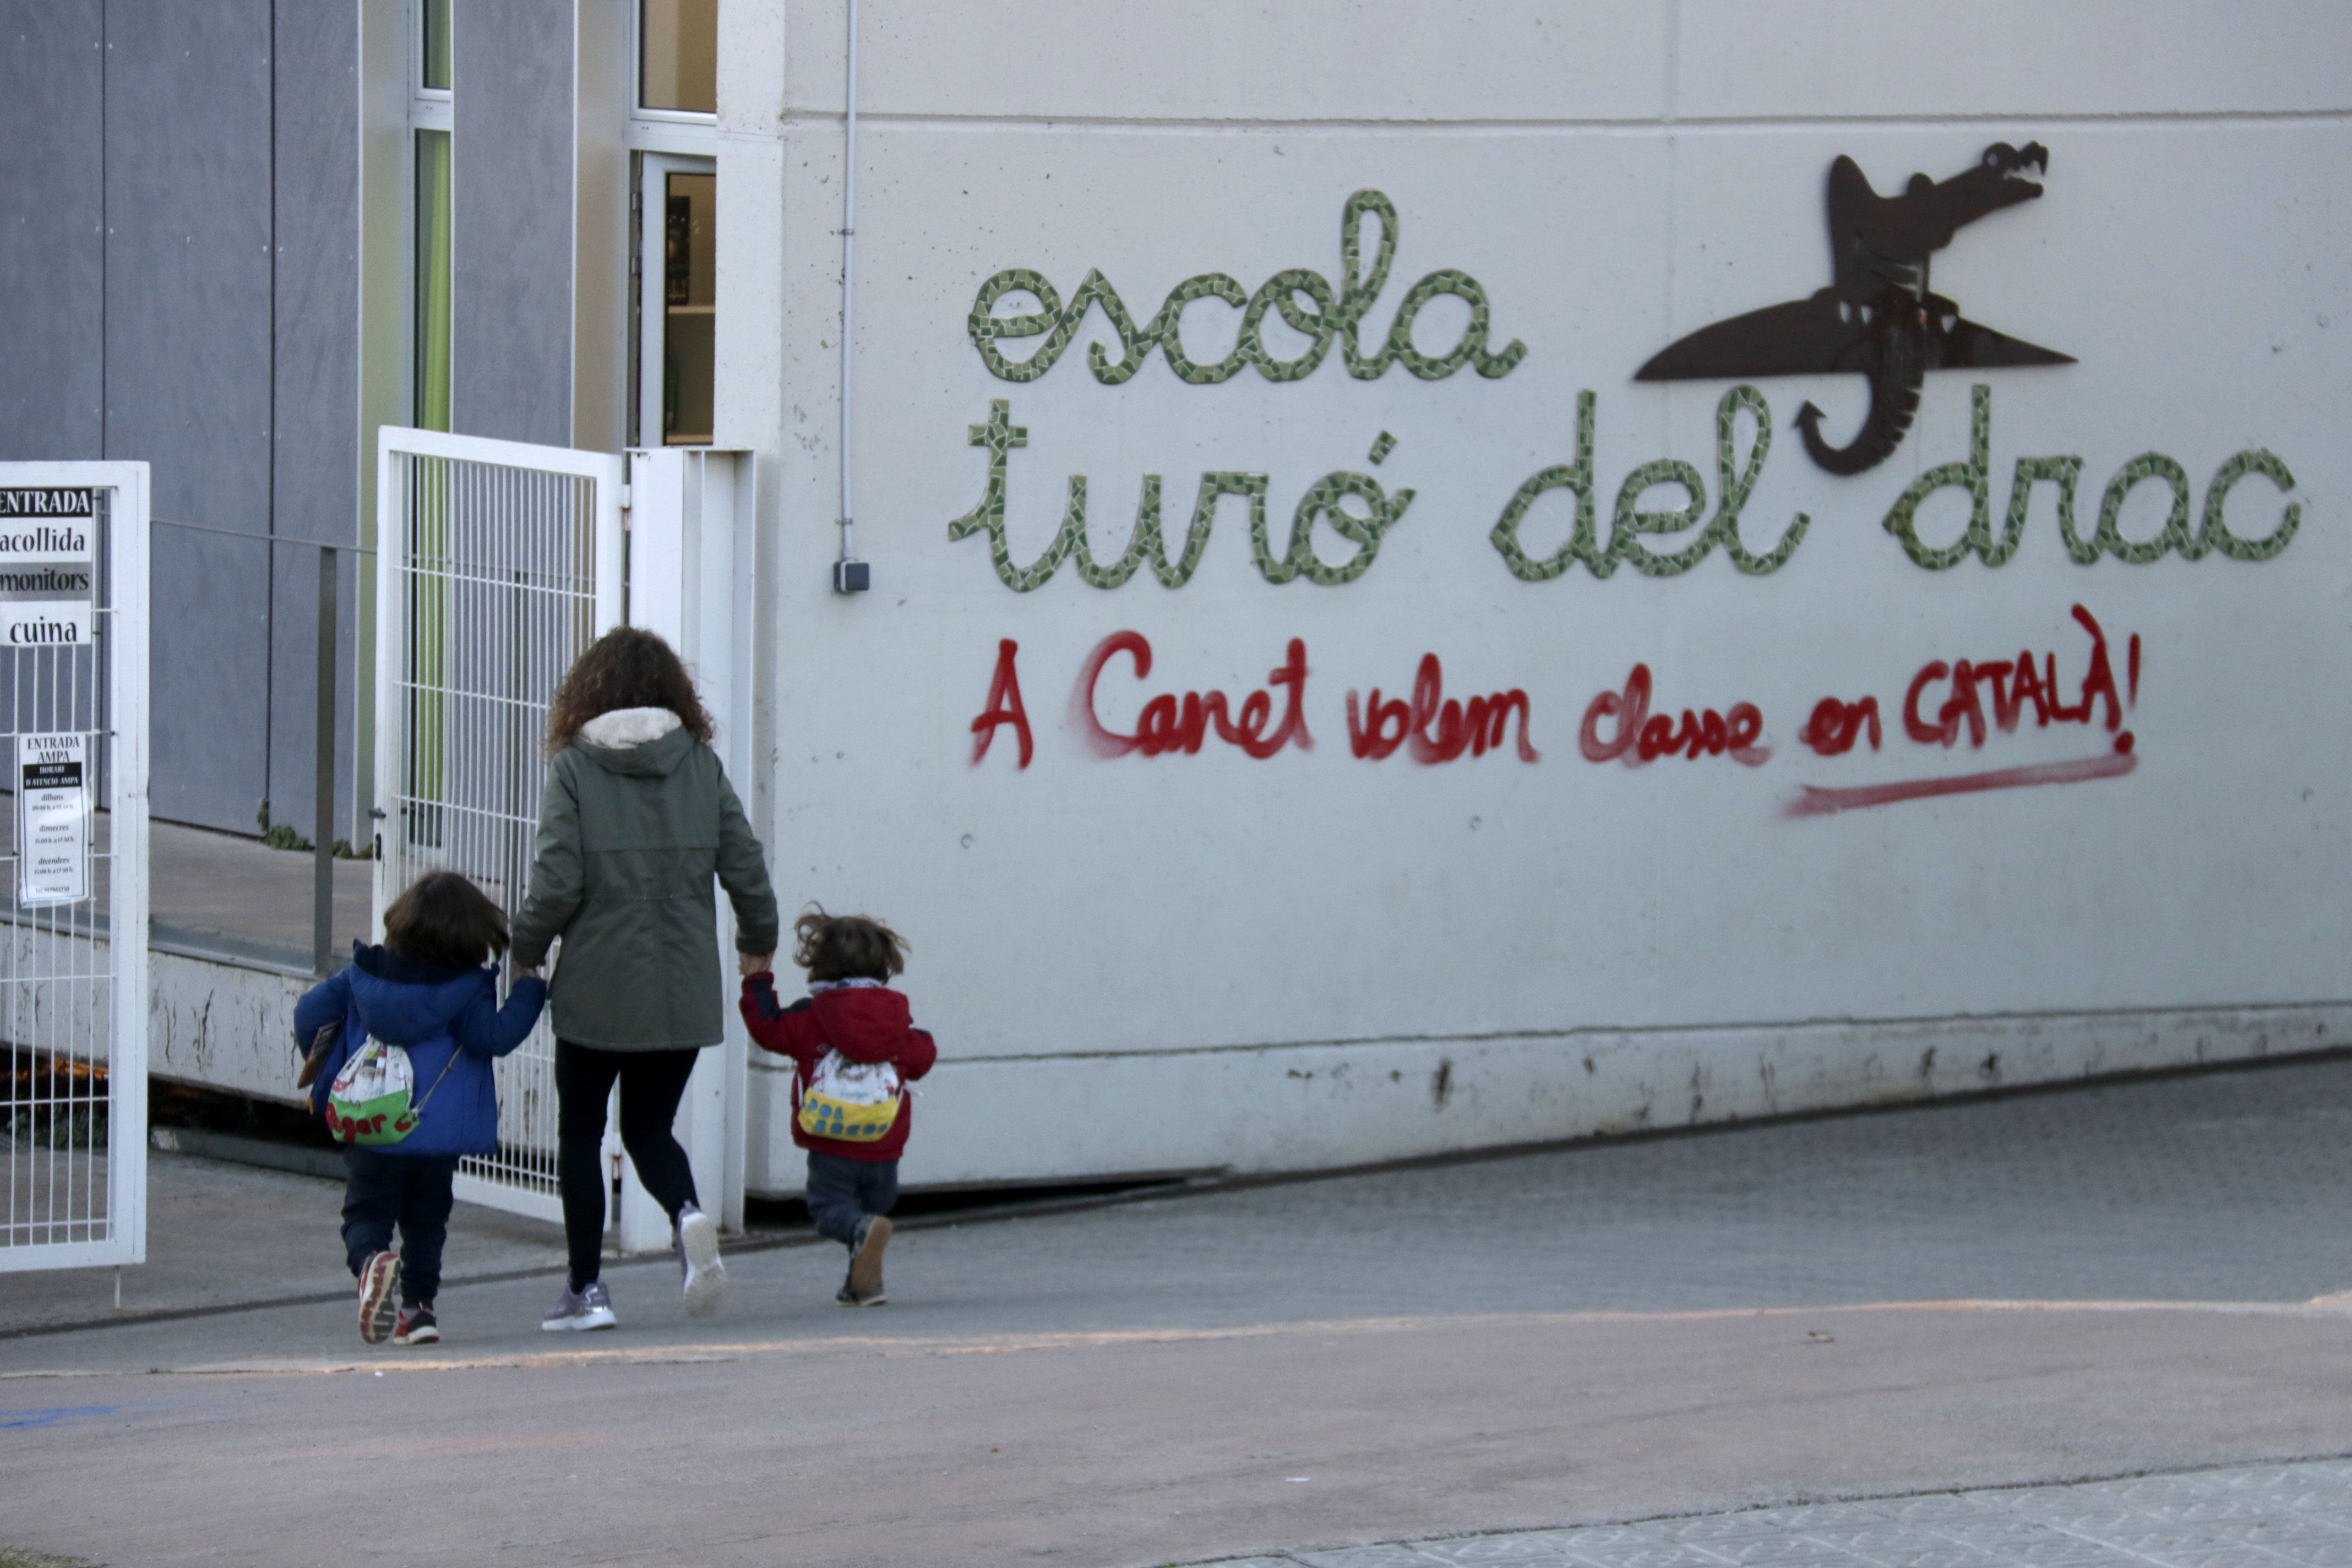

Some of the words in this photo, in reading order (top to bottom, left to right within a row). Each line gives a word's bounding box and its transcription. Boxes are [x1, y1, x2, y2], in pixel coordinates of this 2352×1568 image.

[968, 188, 1528, 385] escola
[948, 398, 1417, 592] turó
[1490, 384, 1811, 581] del
[1882, 384, 2301, 570] drac
[0, 527, 85, 551] acollida
[0, 568, 89, 591] monitors
[9, 616, 77, 643] cuina
[971, 638, 1034, 770] A
[1074, 630, 1313, 760] Canet
[1347, 653, 1539, 765] volem
[1800, 696, 1882, 755] en
[27, 736, 79, 750] ENTRADA
[37, 750, 70, 763] AMPA
[40, 765, 65, 774] HORARI
[39, 856, 69, 865] divendres
